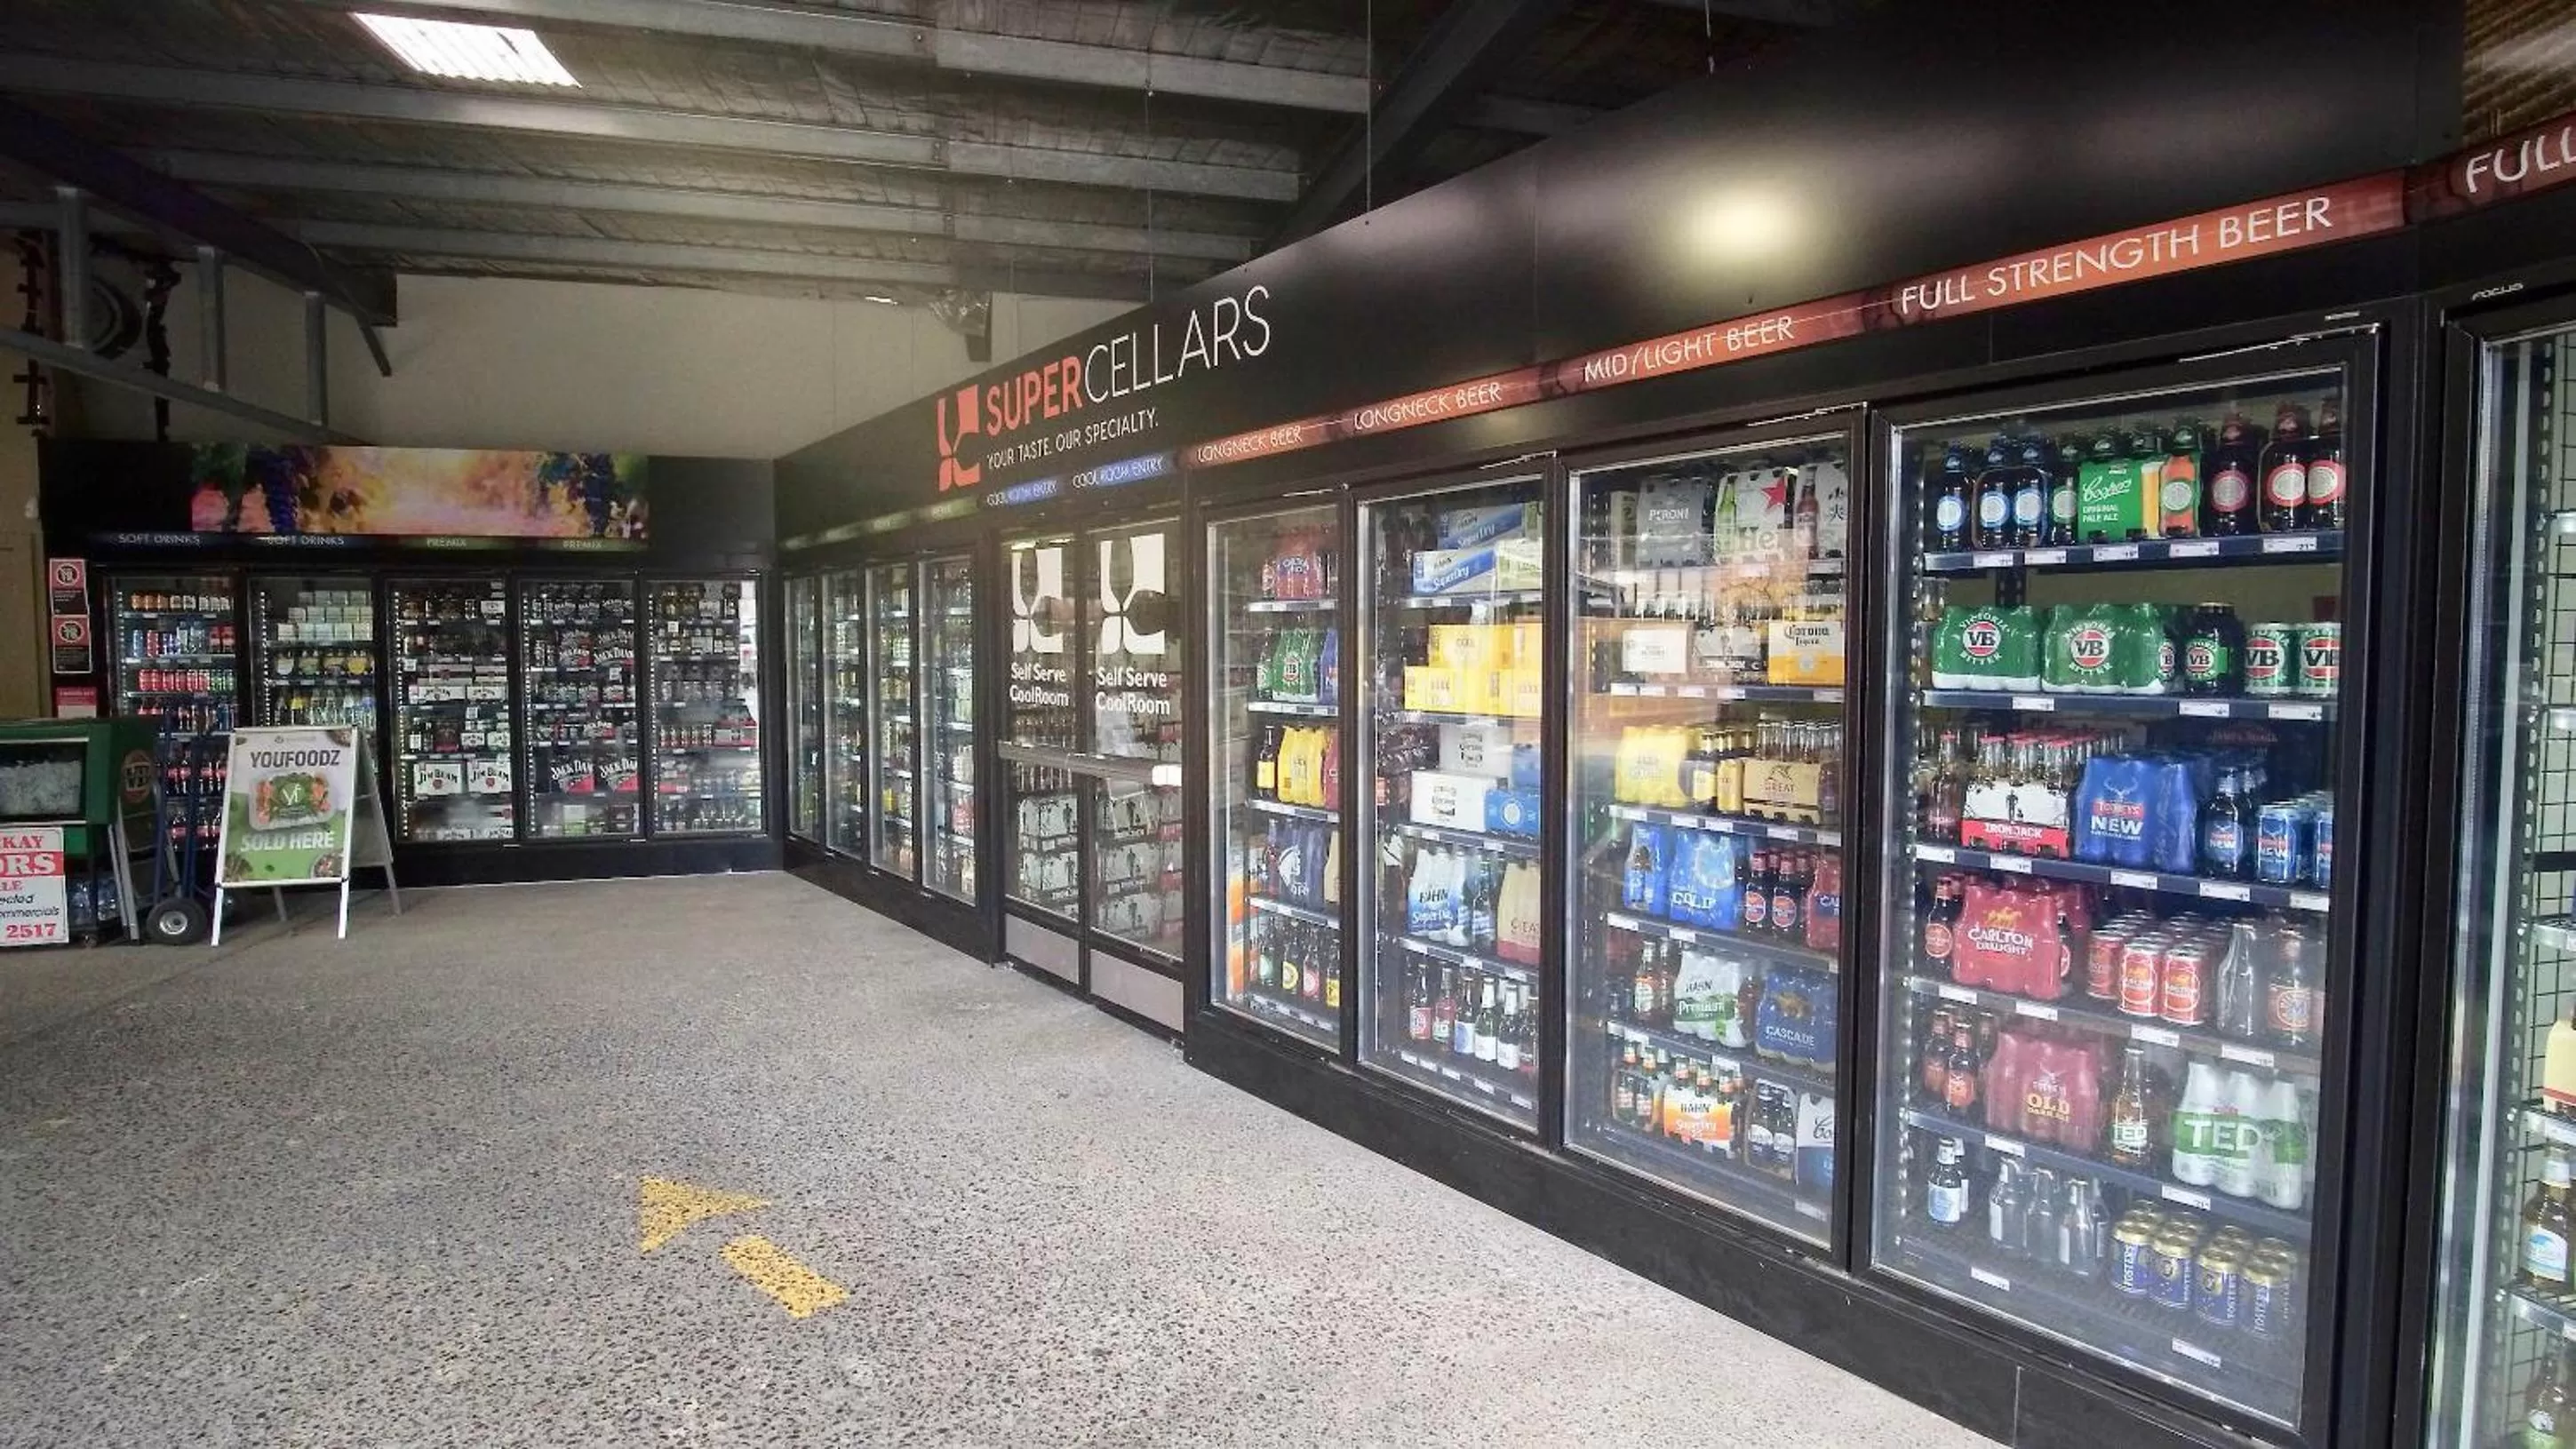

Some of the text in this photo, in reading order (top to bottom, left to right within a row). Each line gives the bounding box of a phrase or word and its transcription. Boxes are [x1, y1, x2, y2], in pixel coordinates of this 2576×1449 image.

[1901, 195, 2335, 314] FULL STRENGTH BEER
[1583, 315, 1796, 383] MID/LIGHT BEER
[1354, 381, 1503, 431] LONGNECK BEER
[987, 447, 1015, 469] YOUR
[1056, 429, 1081, 451] OUR
[1084, 408, 1160, 444] SPECIALTY.
[1197, 426, 1302, 463] LONGNECK BEER
[118, 533, 201, 547] SOFT DRINKS
[301, 535, 345, 545] DRINKS
[1959, 612, 2008, 633] VICTORIA
[1784, 624, 1830, 640] Corona
[1967, 631, 1997, 647] VB
[1960, 649, 2003, 665] BITTER
[2075, 640, 2105, 657] VB
[2245, 649, 2280, 666] VB
[2069, 661, 2114, 676] BITTER
[2189, 655, 2211, 666] VB
[1011, 662, 1067, 682] Self Serve
[1097, 667, 1168, 688] Self Serve
[1096, 691, 1170, 715] CoolRoom
[250, 750, 341, 768] YOUFOODZ
[419, 768, 459, 784] JIM BEAM
[470, 767, 511, 784] JIM BEAM
[1984, 822, 2043, 839] IRON JACK
[2090, 816, 2143, 835] NEW
[240, 830, 335, 852] SOLD HERE
[6, 923, 57, 938] 2517
[1967, 921, 2034, 949] CARLTON
[1975, 941, 2026, 955] DRAUGHT
[1766, 1026, 1815, 1047] CASCADE
[2027, 1092, 2070, 1114] OLD
[2112, 1125, 2148, 1141] TED
[2184, 1119, 2262, 1152] TED
